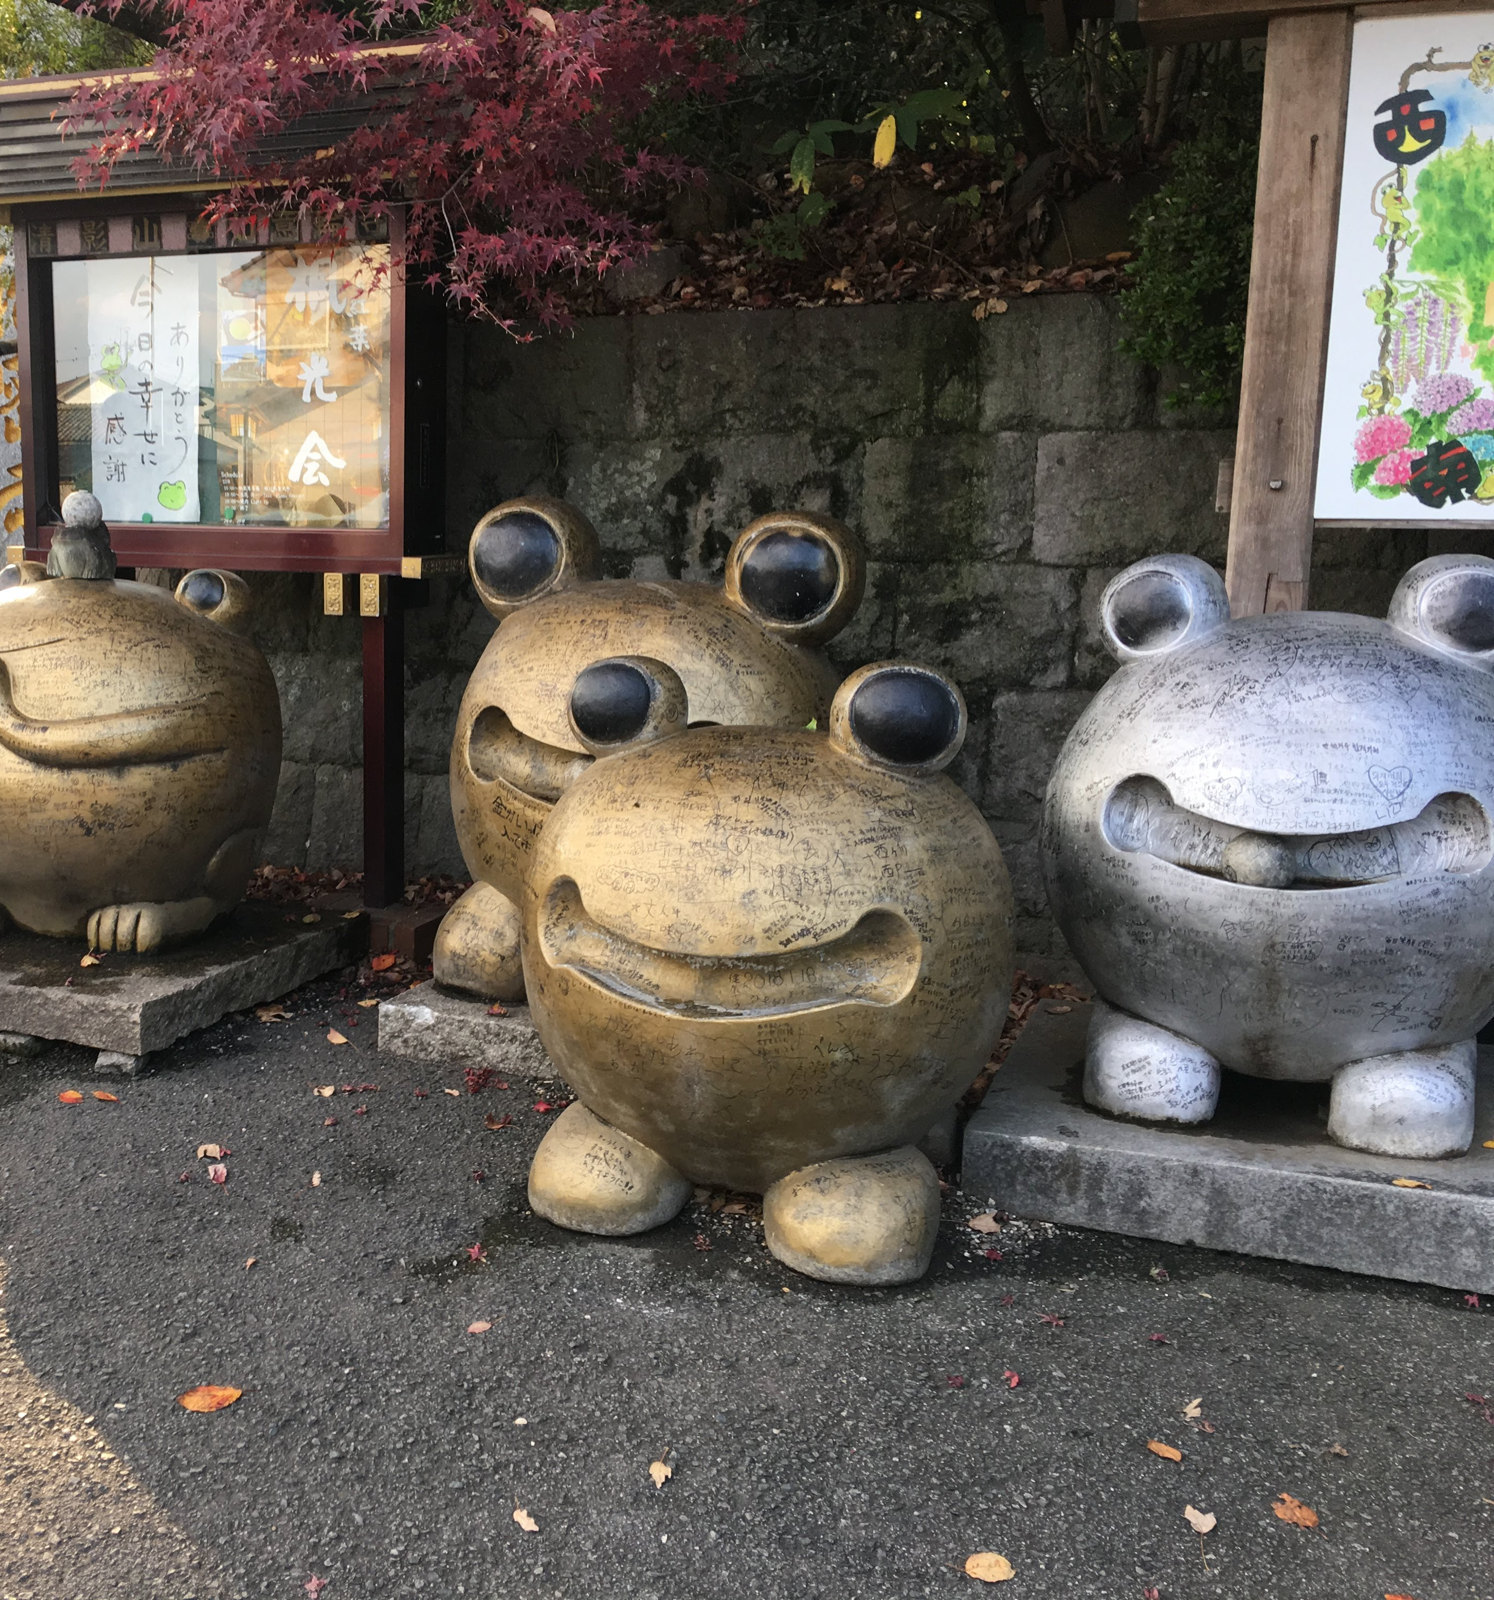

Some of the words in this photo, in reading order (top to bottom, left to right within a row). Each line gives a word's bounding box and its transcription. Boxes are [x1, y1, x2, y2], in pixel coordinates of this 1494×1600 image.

[1373, 89, 1446, 164] 西
[31, 217, 160, 255] 清影山
[127, 274, 164, 467] 今日の幸せに
[166, 321, 192, 477] ありがとう
[102, 414, 128, 484] 感謝
